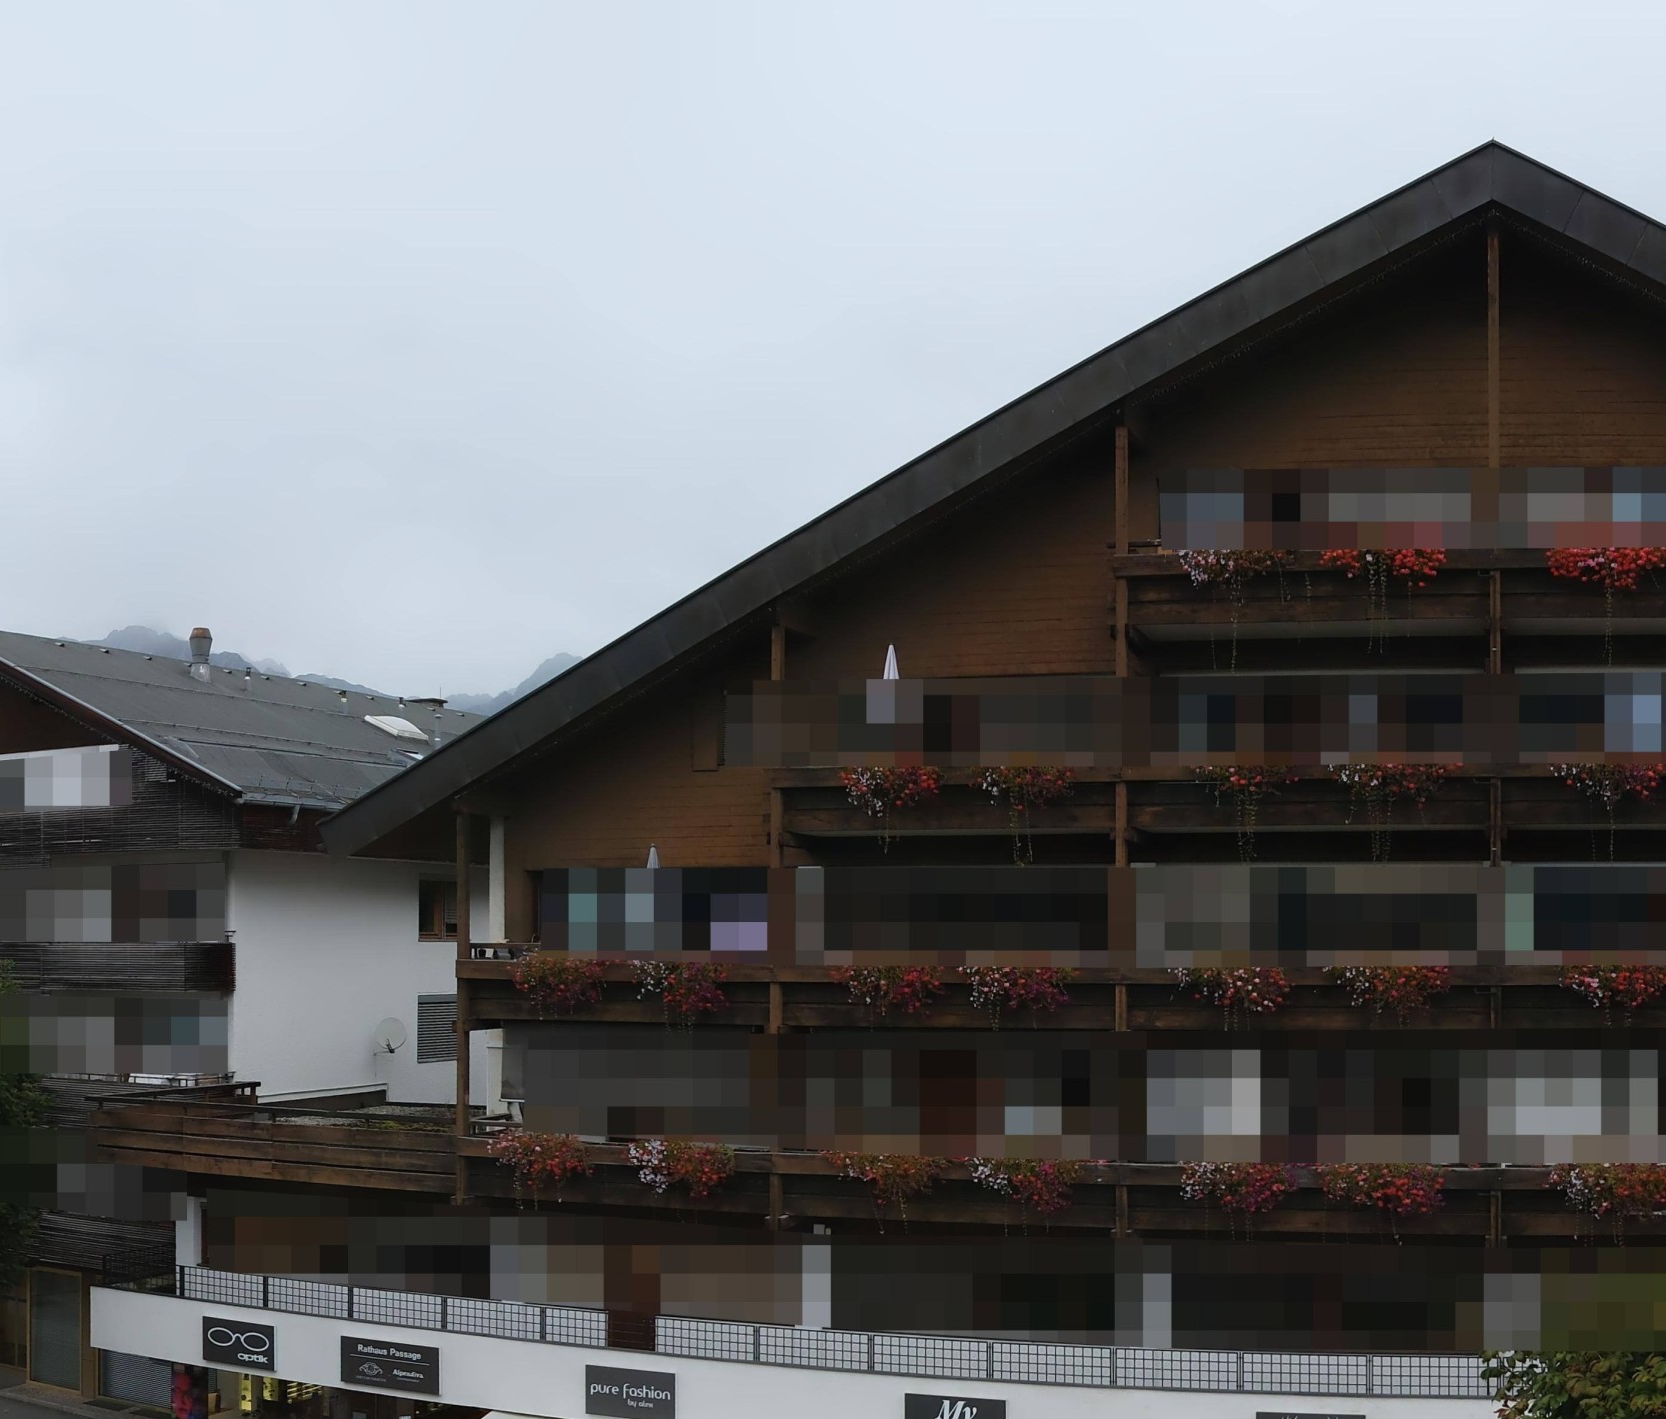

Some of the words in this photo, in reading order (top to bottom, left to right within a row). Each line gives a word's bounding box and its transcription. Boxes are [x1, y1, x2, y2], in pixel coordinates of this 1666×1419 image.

[237, 1352, 268, 1364] optik
[357, 1344, 388, 1355] Rathaus
[389, 1348, 422, 1360] Passage
[590, 1382, 619, 1396] pure
[623, 1383, 671, 1400] fashion
[627, 1399, 637, 1408] by
[638, 1400, 653, 1408] alex
